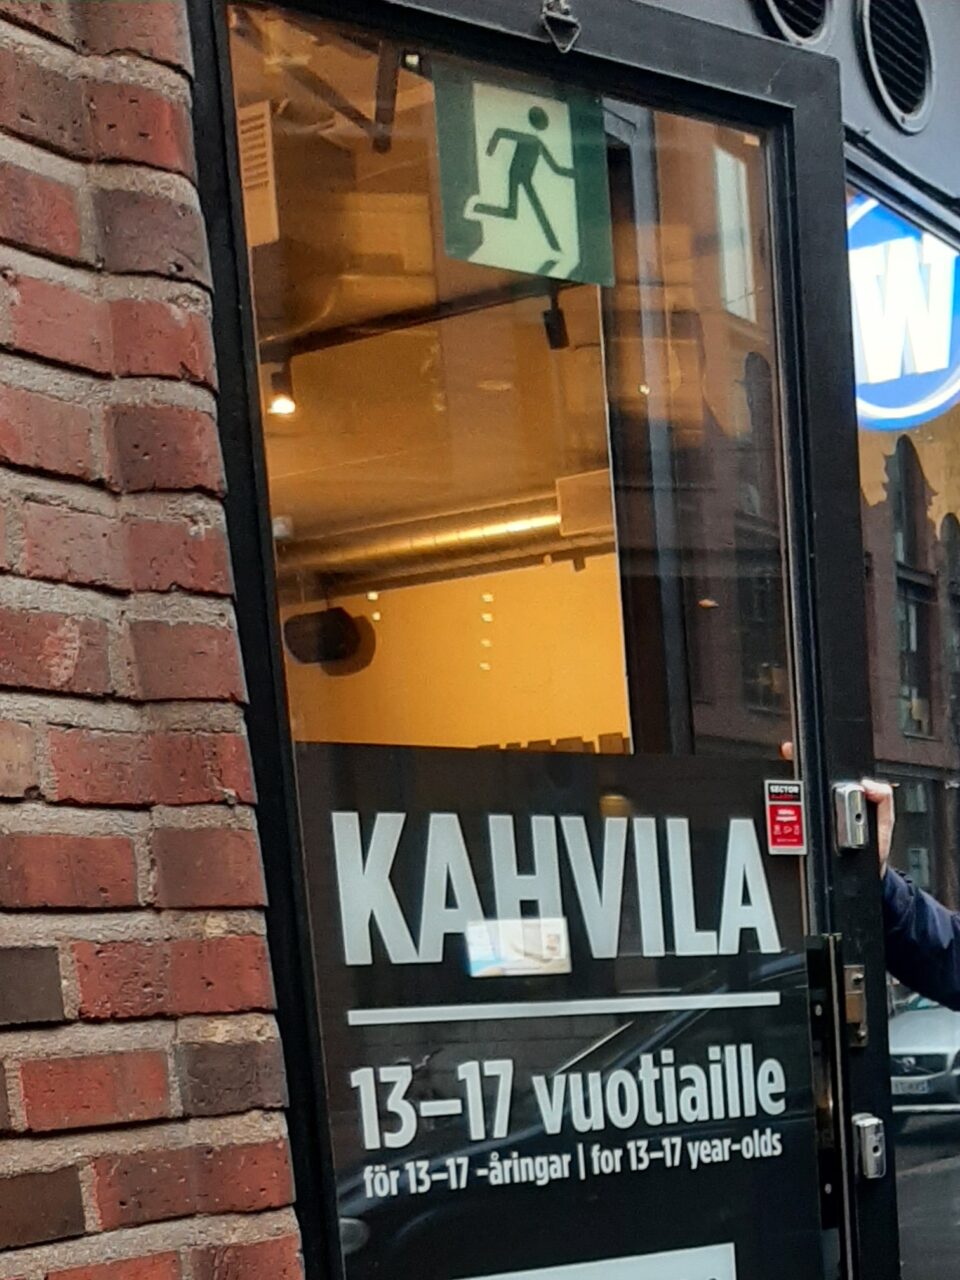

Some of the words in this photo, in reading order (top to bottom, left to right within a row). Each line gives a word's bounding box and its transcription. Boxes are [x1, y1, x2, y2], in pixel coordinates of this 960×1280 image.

[769, 785, 800, 794] SECTOR
[331, 812, 782, 966] KAHVILA
[350, 1059, 514, 1150] 13–17
[532, 1043, 787, 1135] vuotiaille
[363, 1164, 400, 1197] för
[591, 1143, 623, 1171] for
[688, 1127, 783, 1169] year-olds
